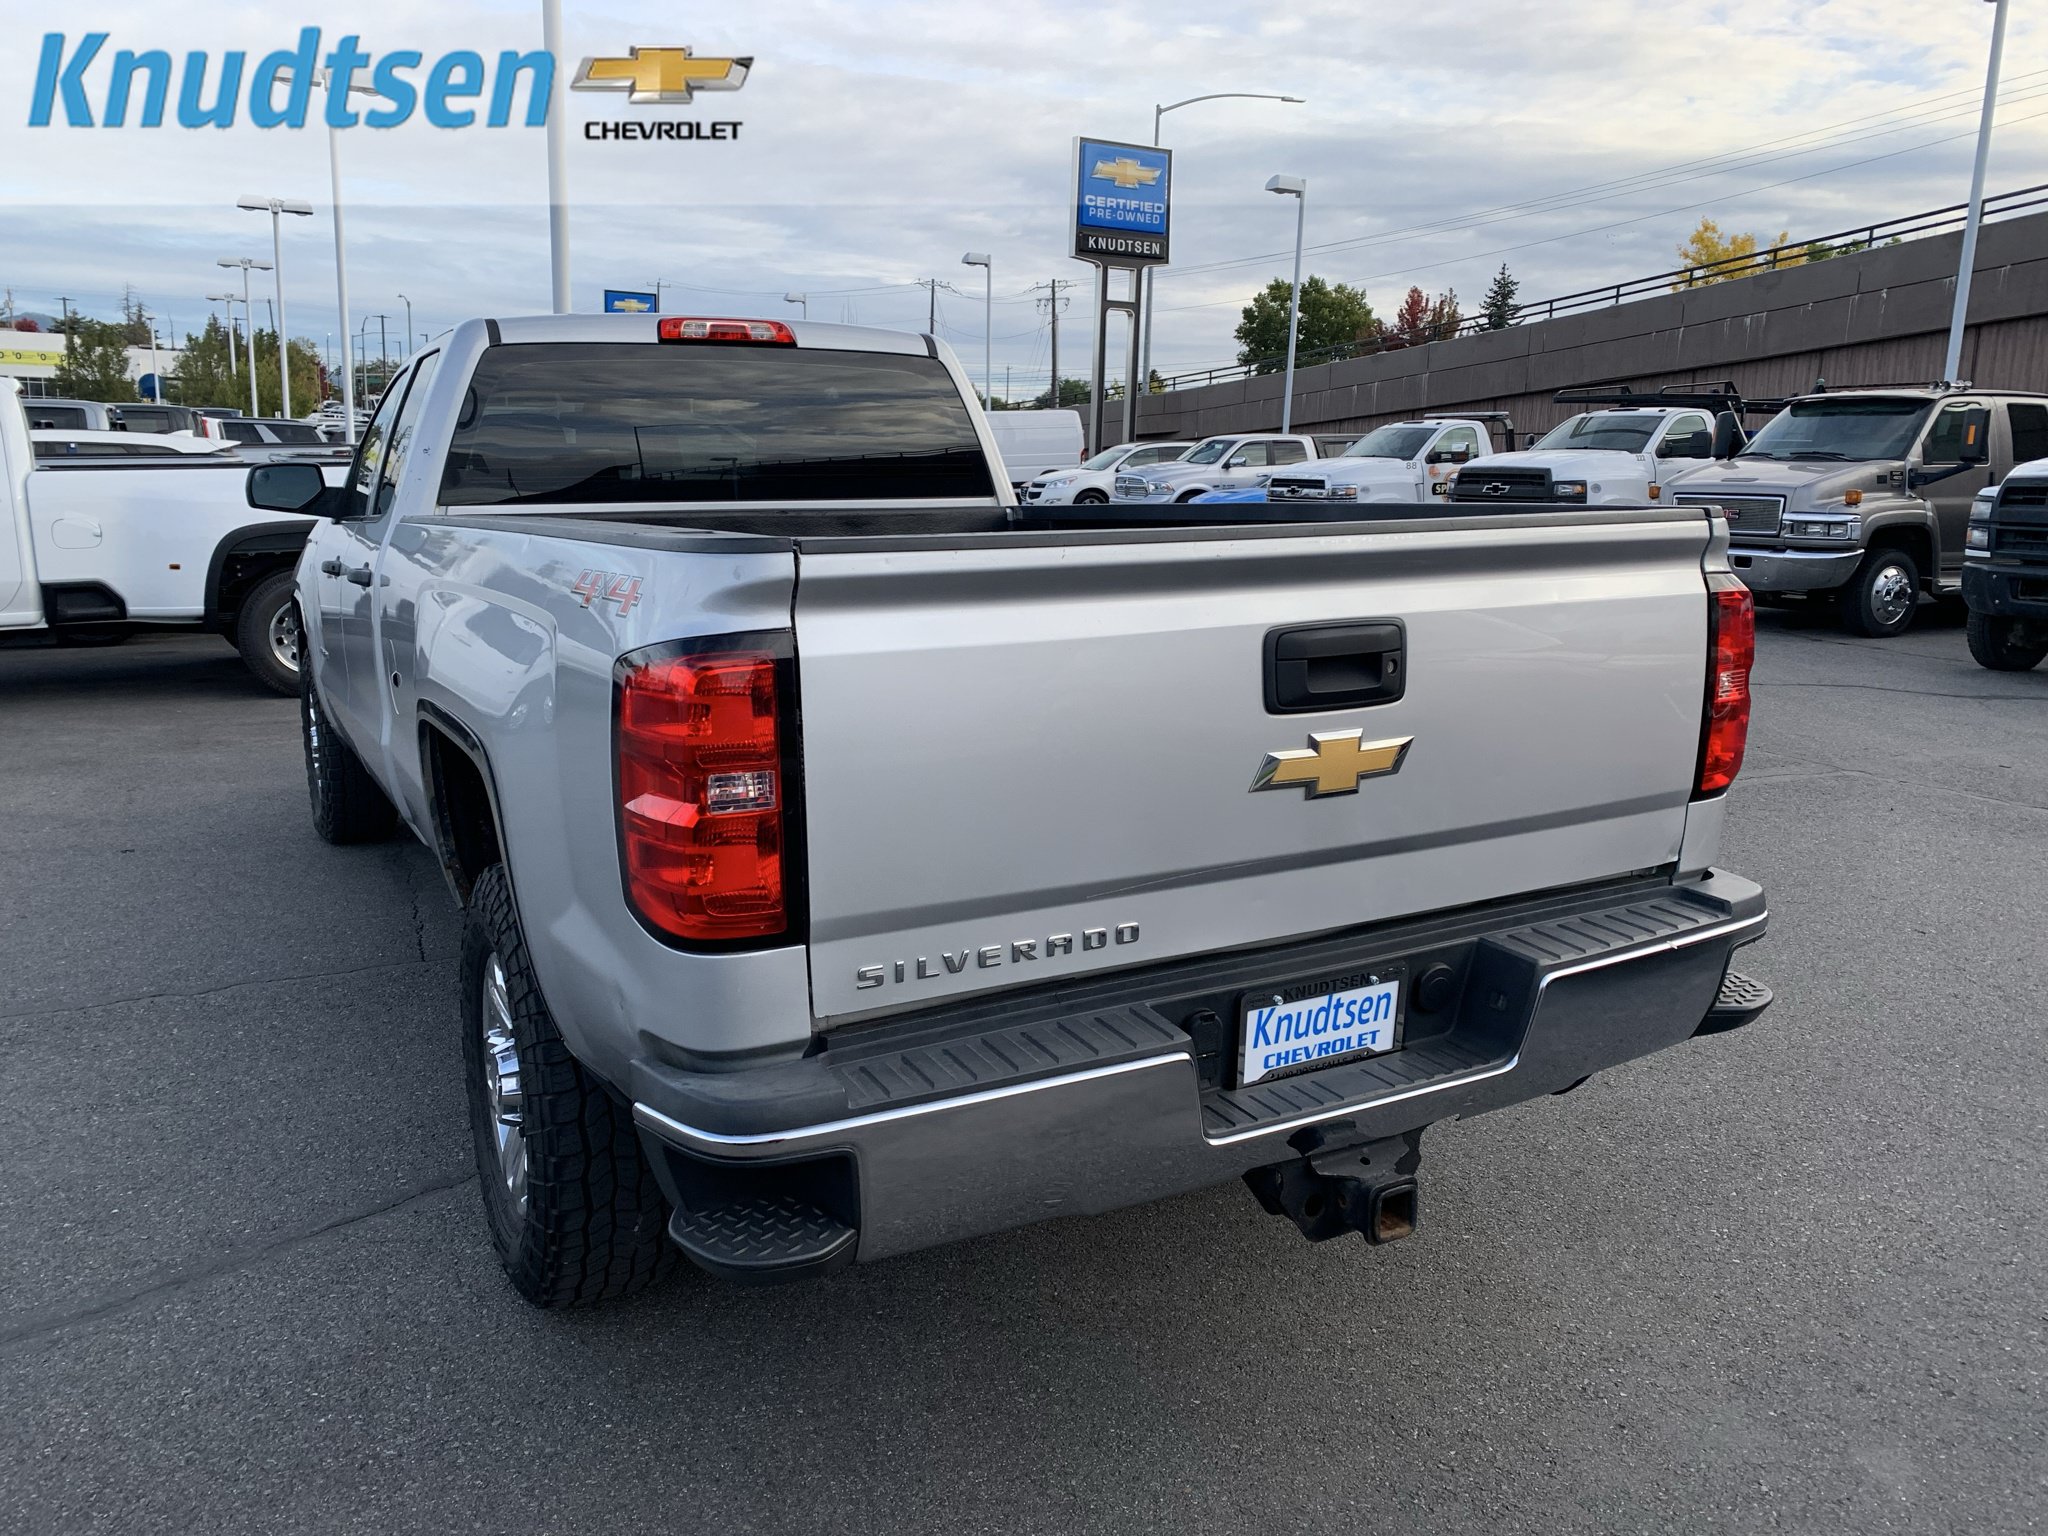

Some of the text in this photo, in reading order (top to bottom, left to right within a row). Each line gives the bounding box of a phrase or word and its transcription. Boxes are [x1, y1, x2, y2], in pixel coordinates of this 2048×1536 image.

[1085, 195, 1165, 213] CERTIFIED
[1089, 207, 1160, 224] PRE-OWNED
[1088, 236, 1160, 254] KNUDTSEN
[1435, 484, 1448, 494] SP
[857, 922, 1140, 990] SILVERADO
[1282, 973, 1371, 1001] KNUDTSEN
[1253, 991, 1392, 1049] Knudtsen
[1263, 1030, 1380, 1069] CHEVROLET
